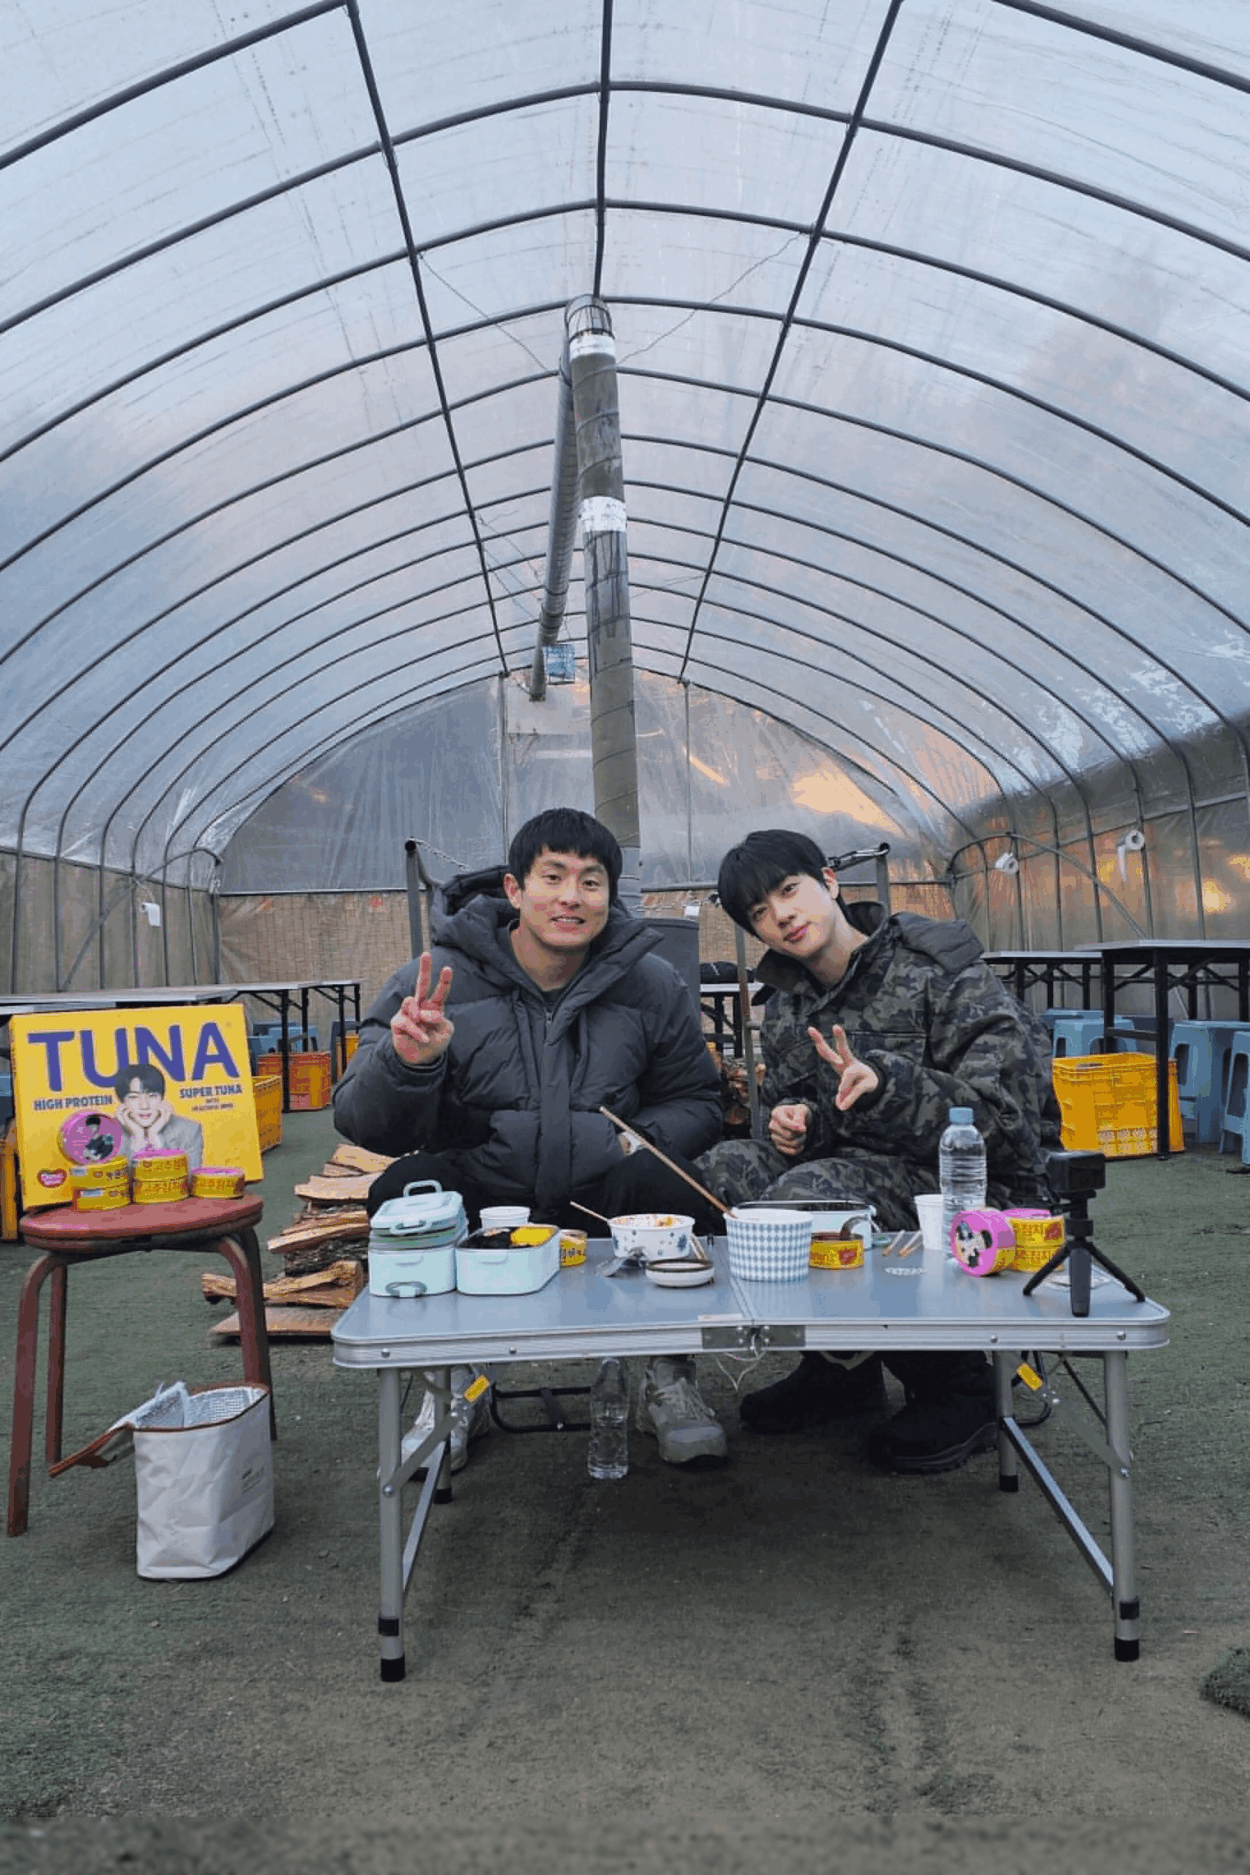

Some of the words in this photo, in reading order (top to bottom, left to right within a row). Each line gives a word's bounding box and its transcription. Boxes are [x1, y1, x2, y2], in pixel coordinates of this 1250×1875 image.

[27, 1022, 240, 1092] TUNA
[180, 1087, 212, 1098] SUPER
[215, 1084, 242, 1095] TUNA
[34, 1099, 62, 1110] HIGH
[64, 1095, 112, 1108] PROTEIN
